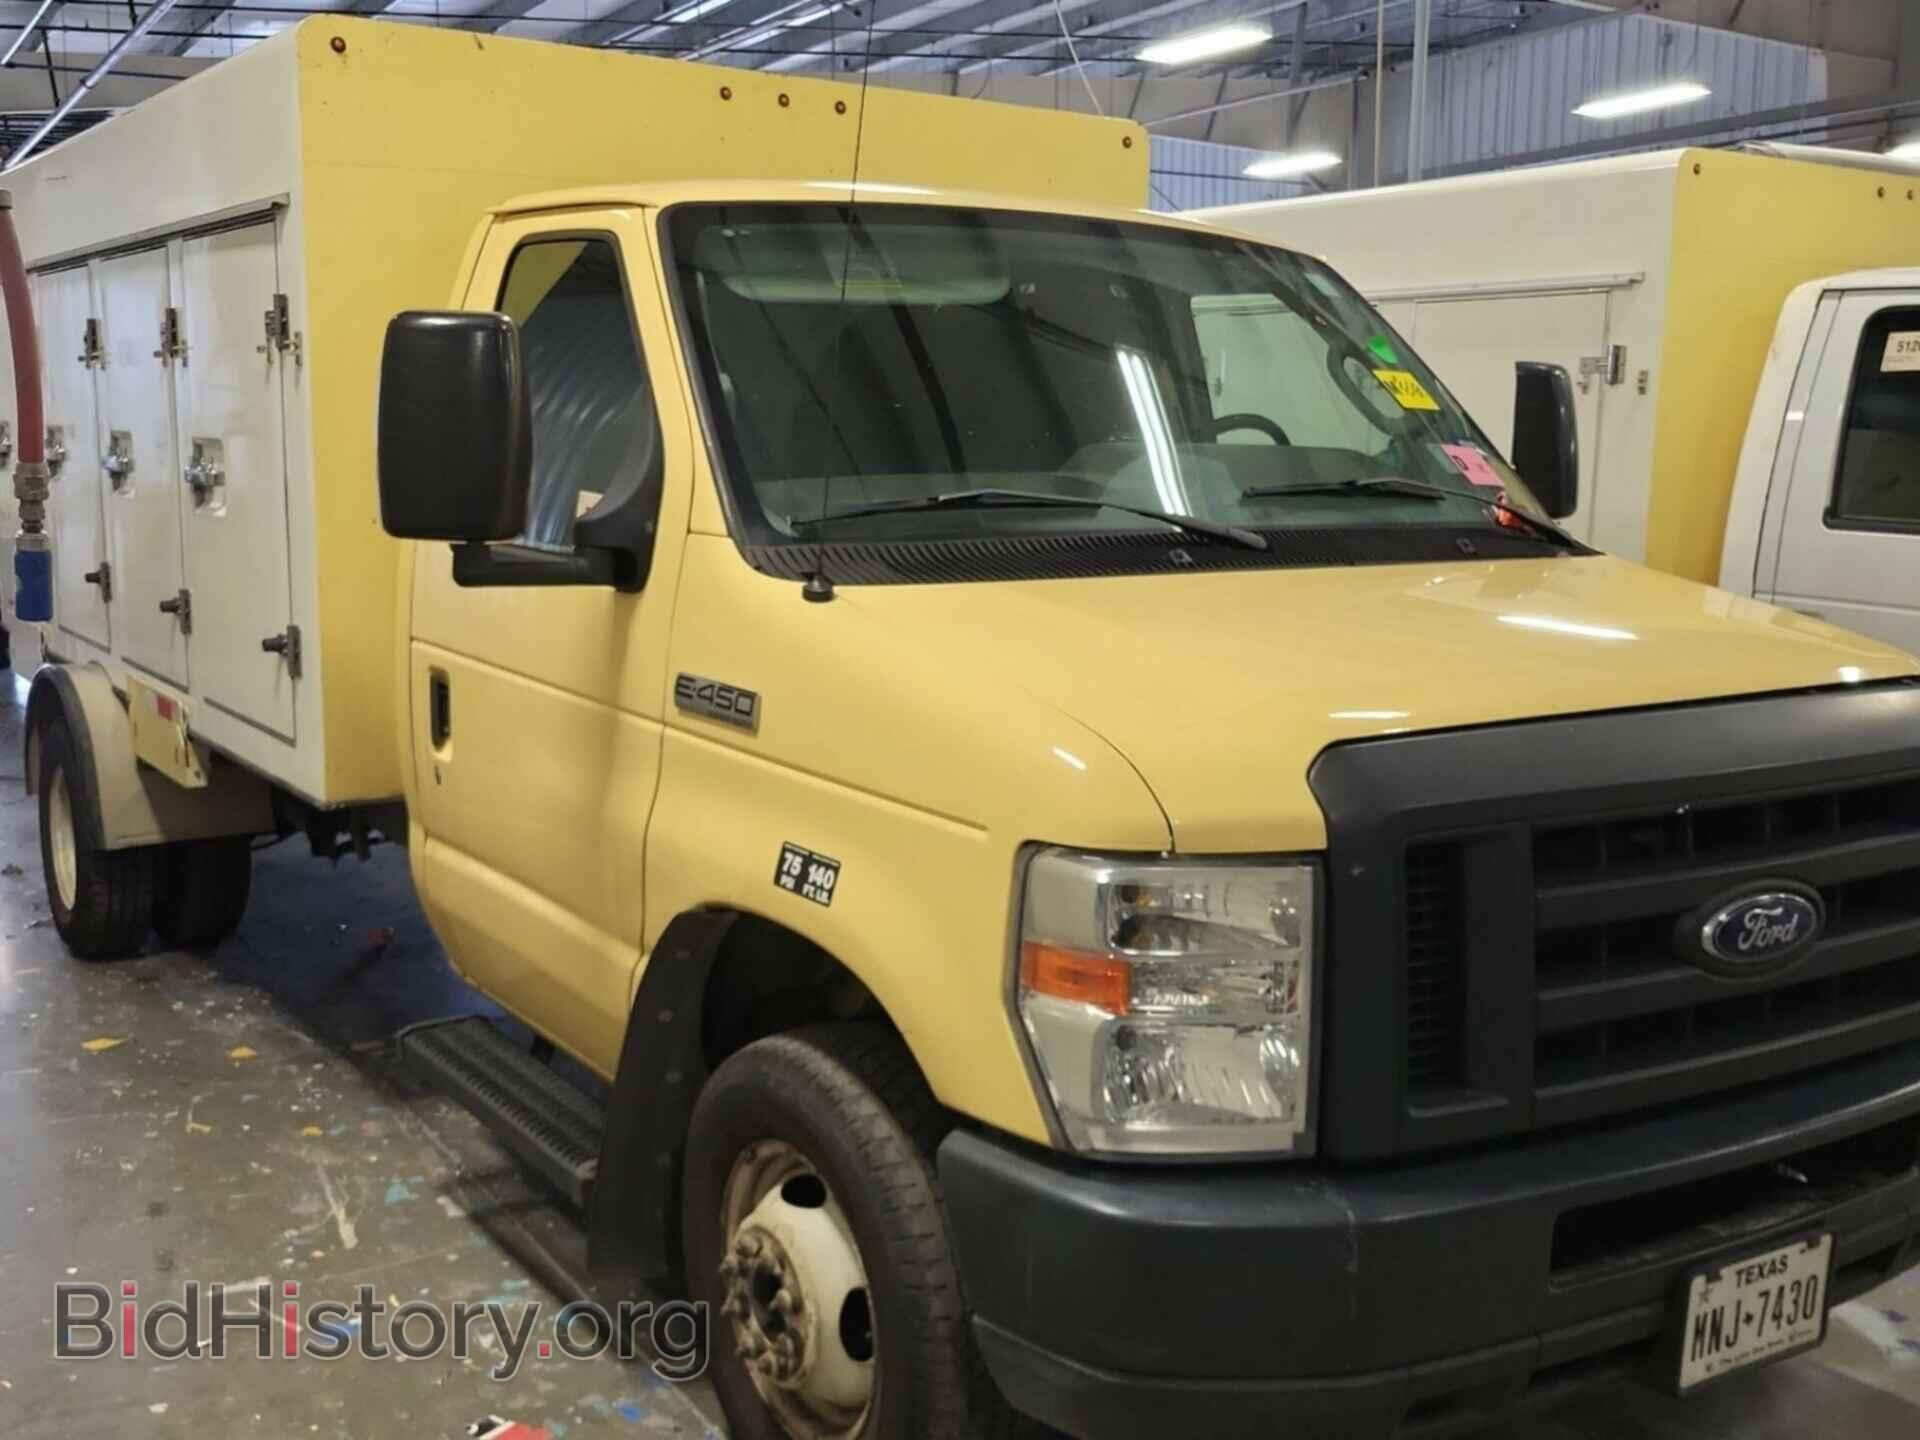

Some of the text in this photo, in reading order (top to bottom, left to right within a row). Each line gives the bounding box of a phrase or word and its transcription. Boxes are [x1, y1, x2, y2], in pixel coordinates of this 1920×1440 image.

[1896, 340, 1920, 352] 512
[676, 674, 754, 716] E-450
[782, 851, 803, 876] 75
[807, 863, 836, 890] 140
[1738, 907, 1798, 950] Ford
[1736, 1254, 1788, 1288] TEXAS
